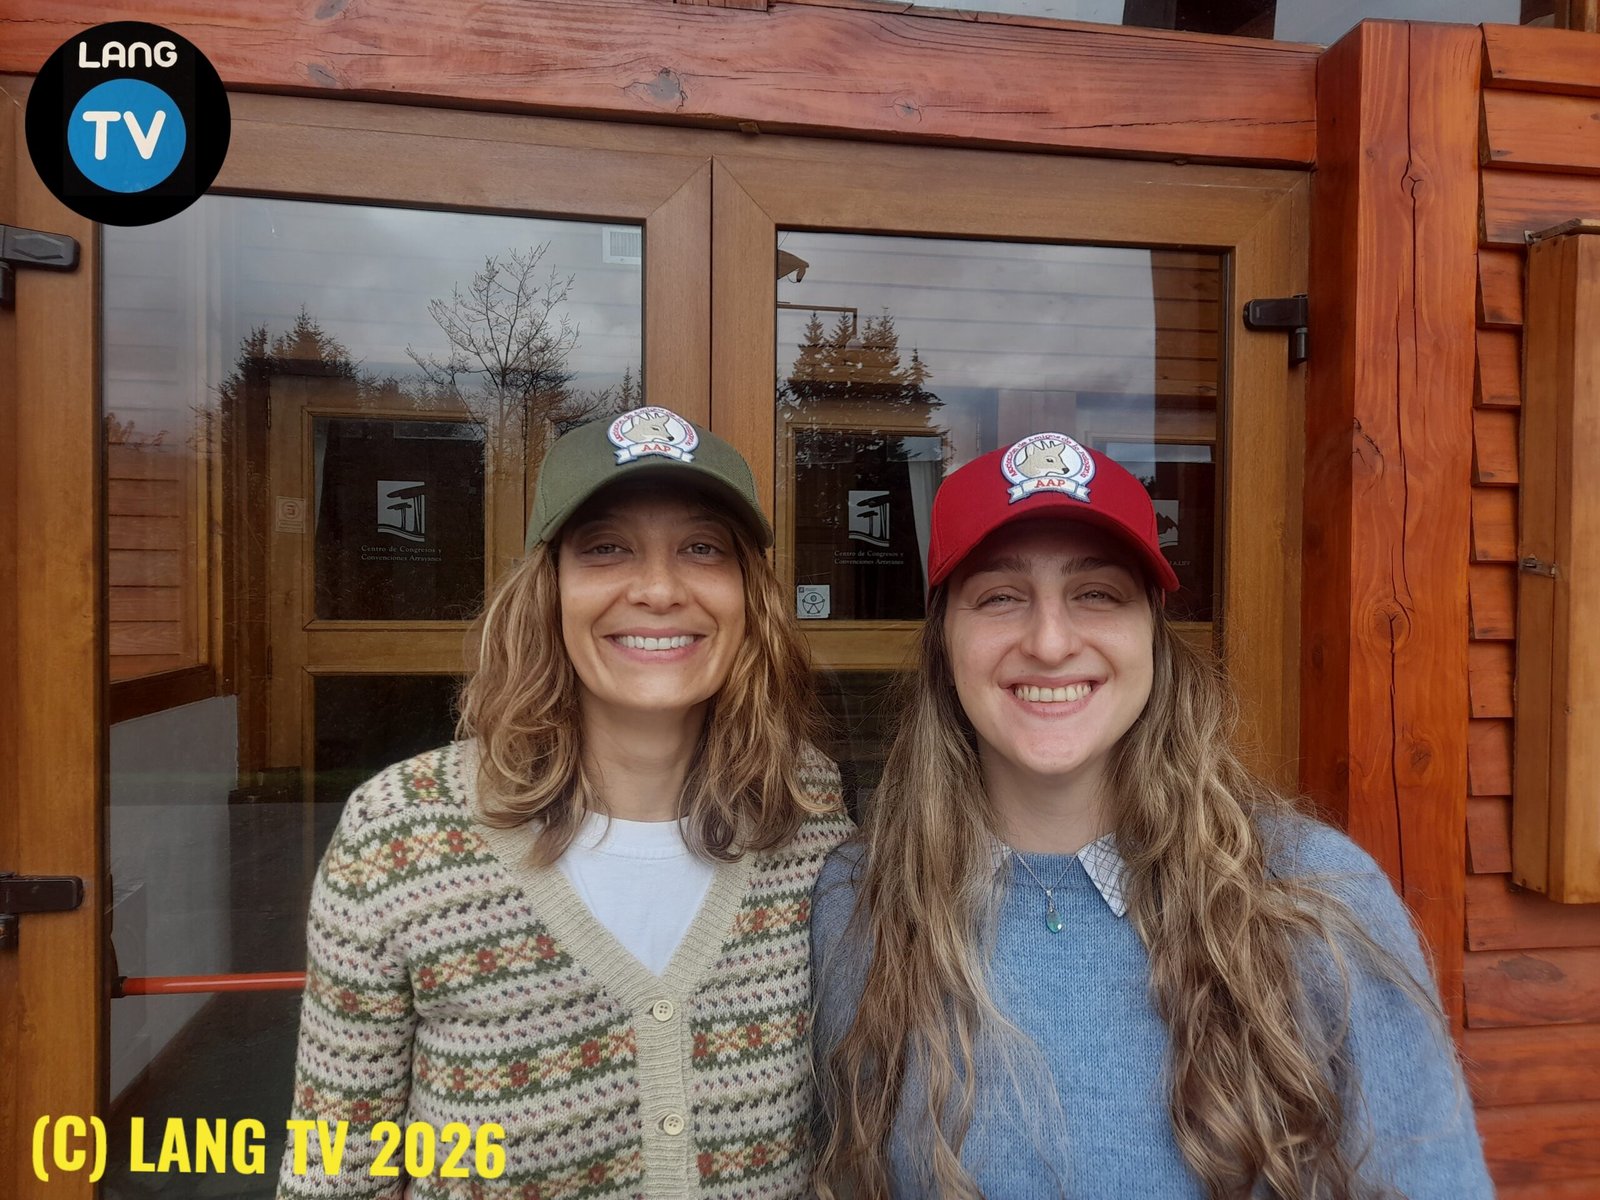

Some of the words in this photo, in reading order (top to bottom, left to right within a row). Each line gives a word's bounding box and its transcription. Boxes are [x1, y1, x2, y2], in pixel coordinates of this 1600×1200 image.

[641, 444, 672, 453] AAP
[1034, 479, 1066, 489] AAP
[361, 544, 387, 552] Centro
[400, 545, 436, 554] Congresos
[361, 553, 408, 561] Convenciones
